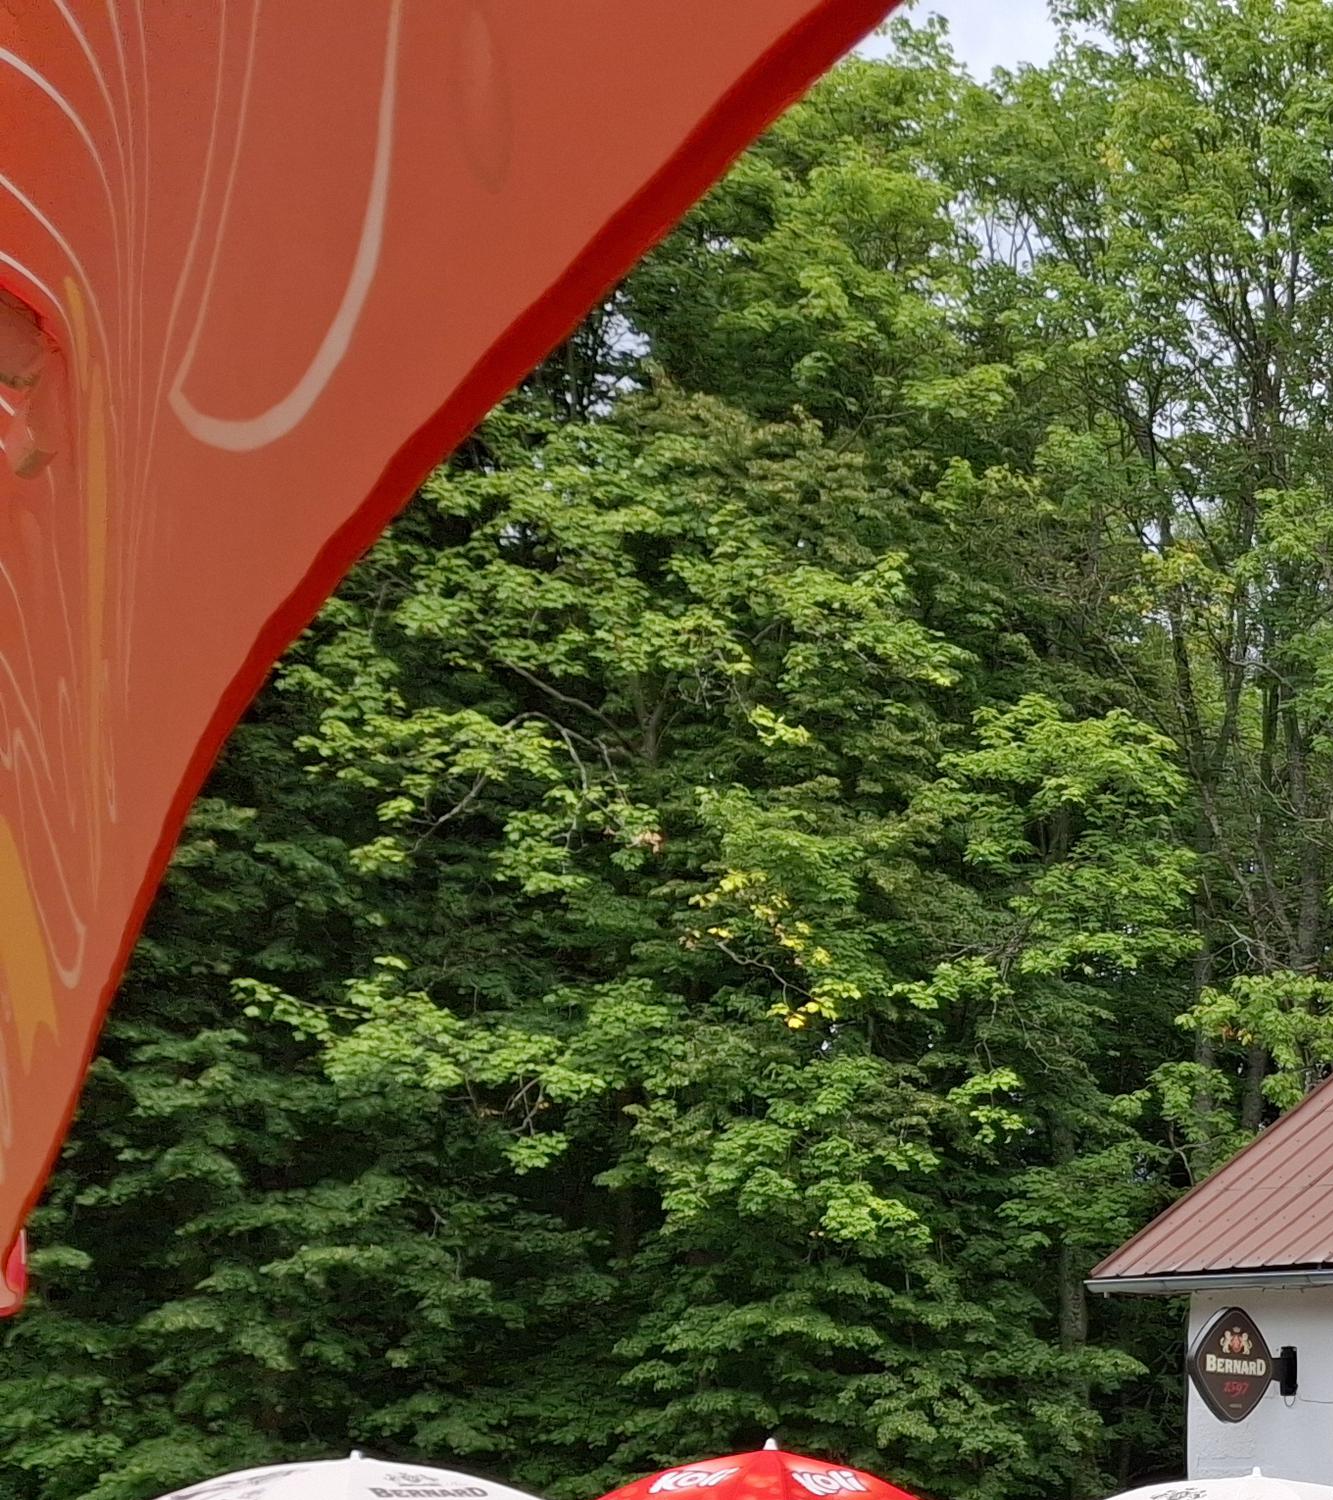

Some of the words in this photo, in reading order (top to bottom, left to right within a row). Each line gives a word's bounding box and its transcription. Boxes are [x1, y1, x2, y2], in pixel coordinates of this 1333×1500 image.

[1205, 1354, 1266, 1376] BERNARD
[368, 1487, 489, 1498] BERNARD
[649, 1467, 740, 1494] Koli
[791, 1470, 870, 1496] Koli
